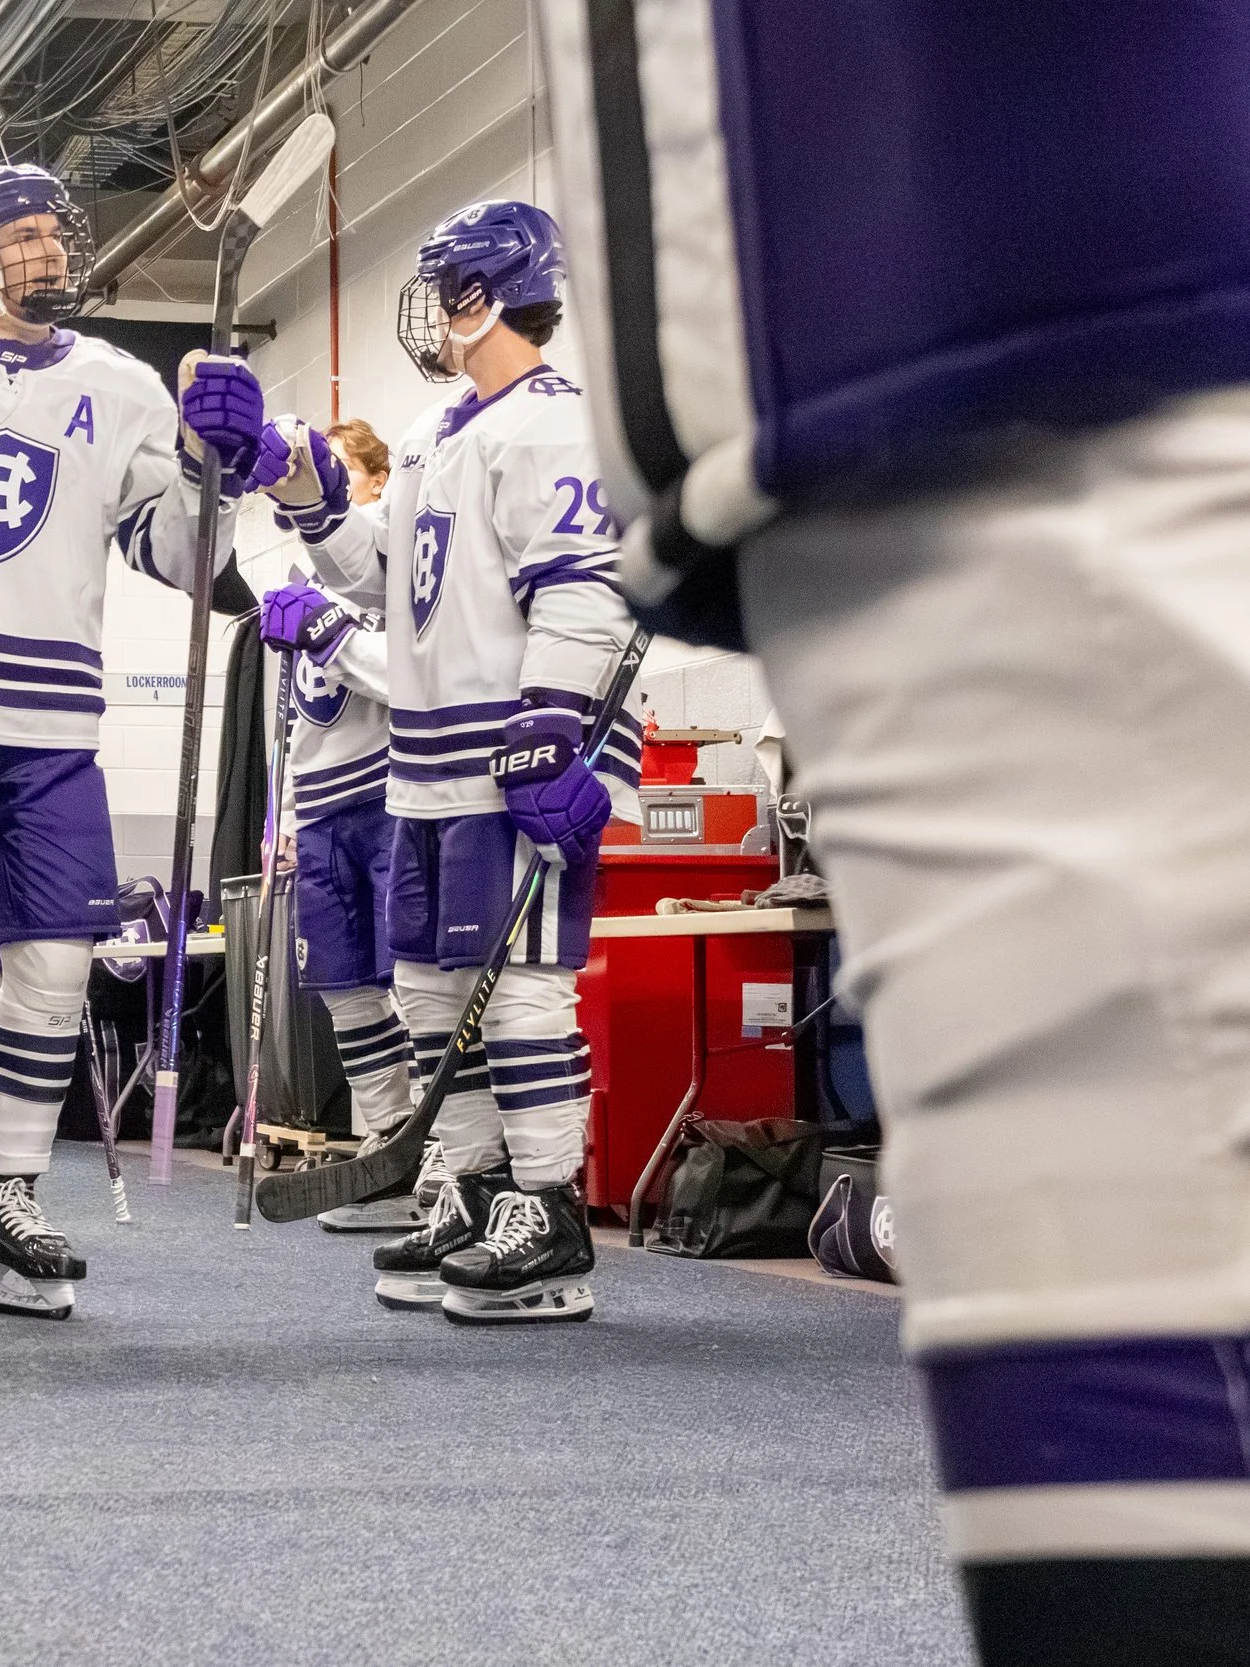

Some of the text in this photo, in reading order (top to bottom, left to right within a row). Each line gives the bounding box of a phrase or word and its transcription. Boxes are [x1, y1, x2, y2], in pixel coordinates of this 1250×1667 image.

[0, 351, 27, 364] SP
[64, 394, 94, 445] A
[401, 454, 425, 469] AH
[551, 475, 614, 536] 29
[153, 690, 159, 701] 4
[456, 968, 497, 1053] FLYLITE
[48, 1015, 71, 1027] SP
